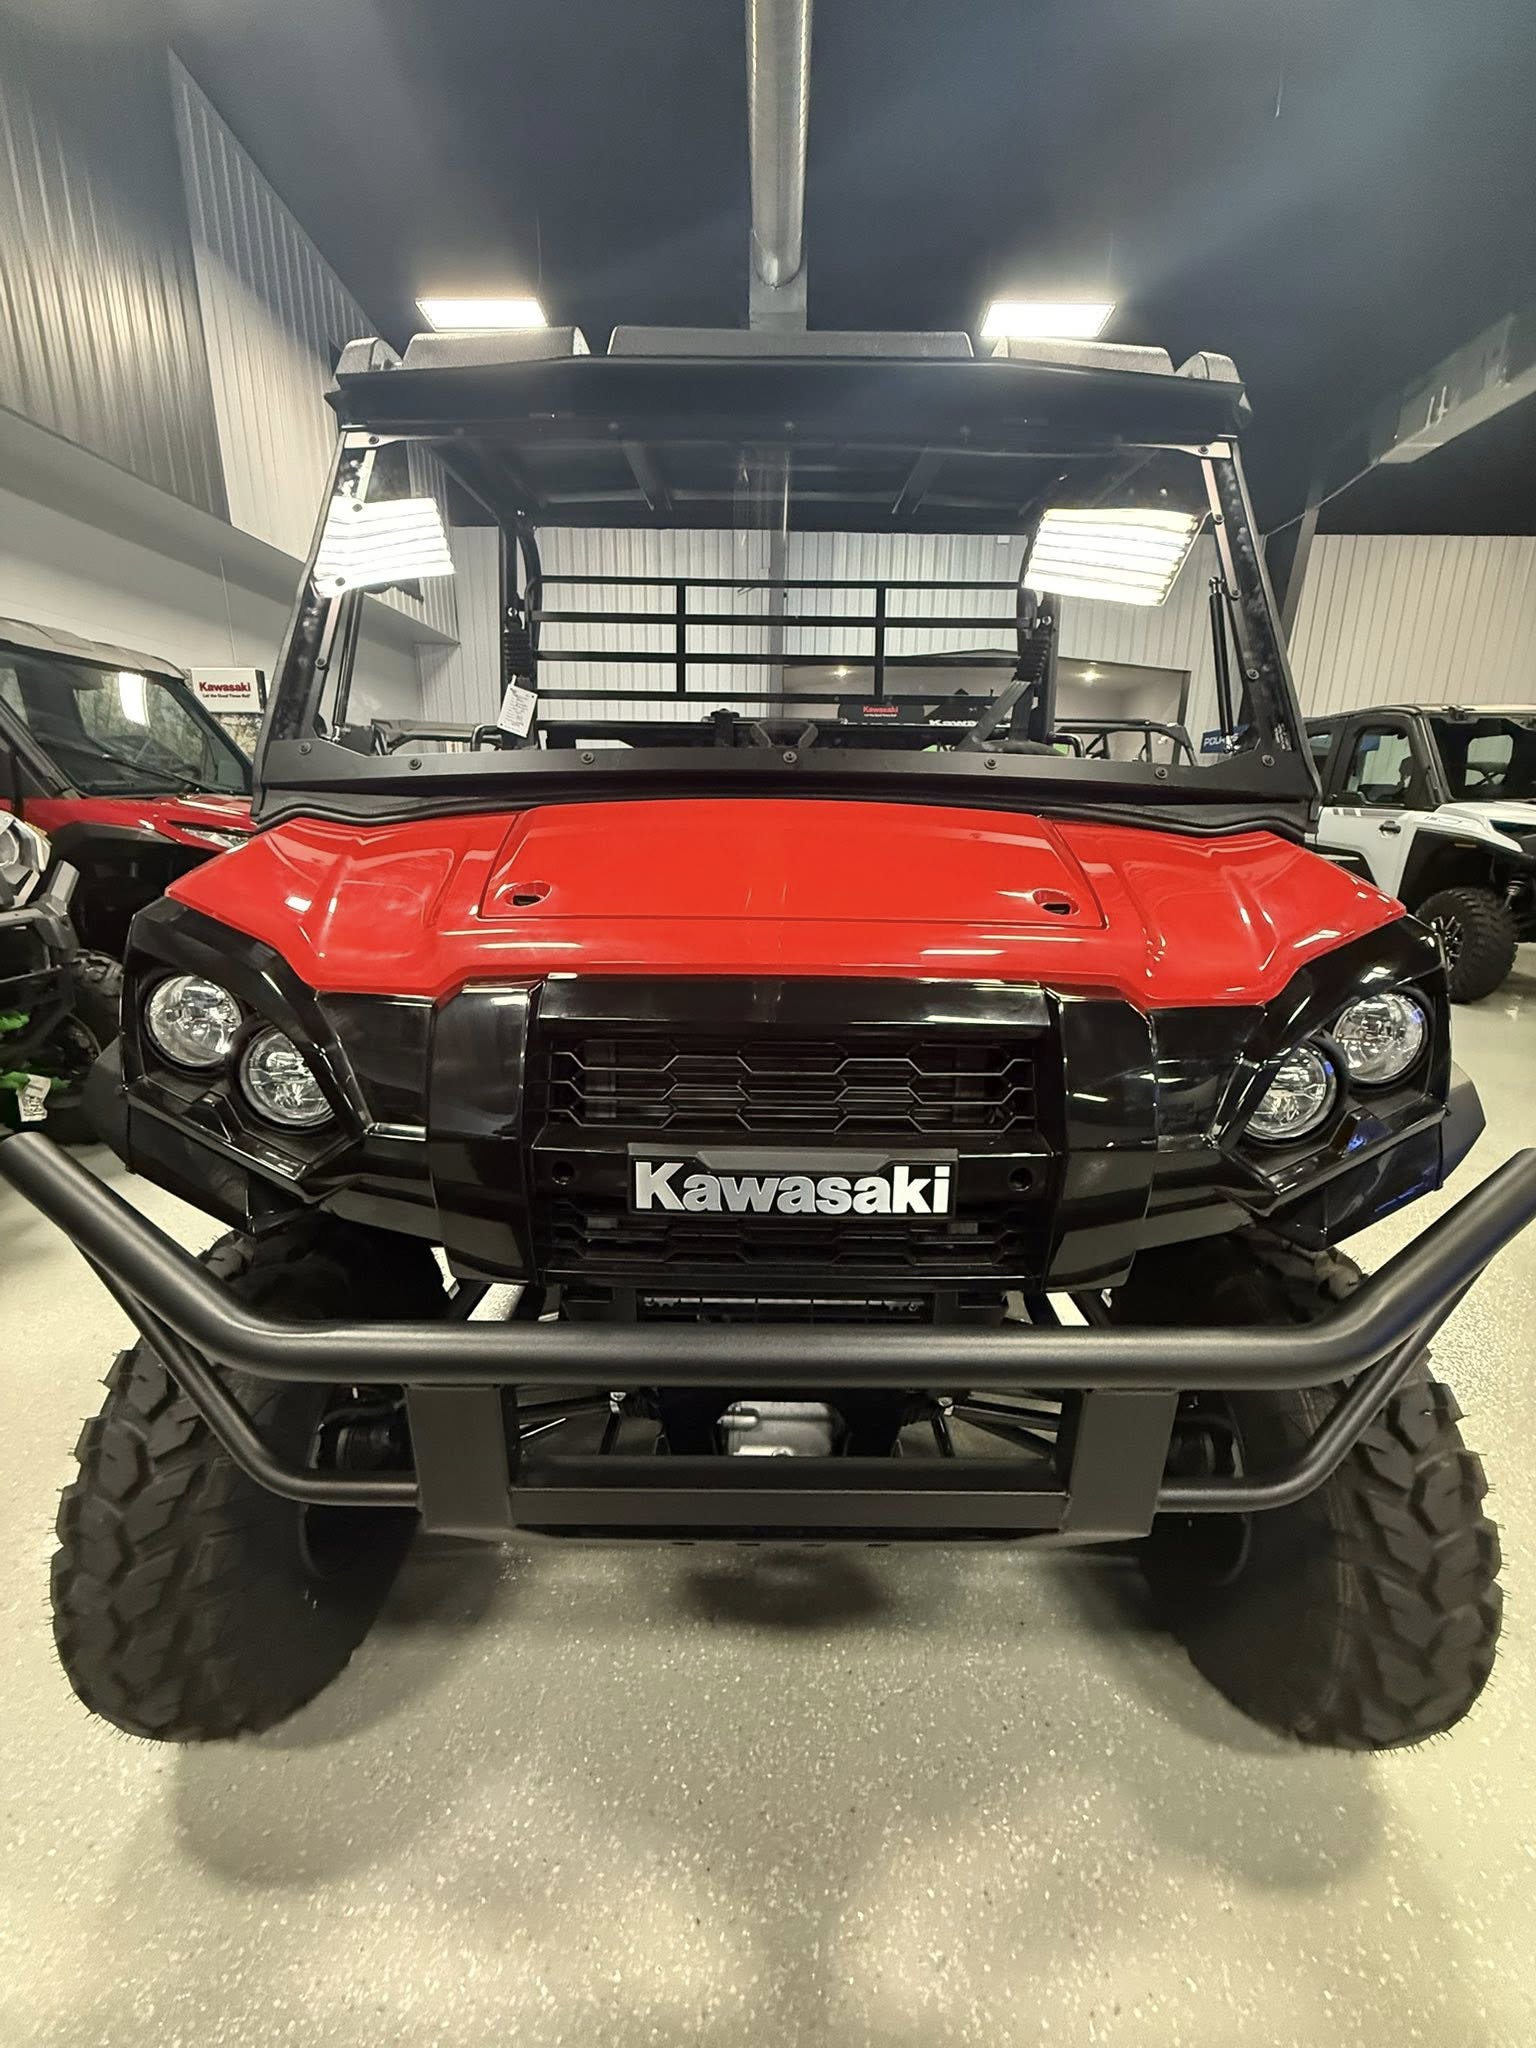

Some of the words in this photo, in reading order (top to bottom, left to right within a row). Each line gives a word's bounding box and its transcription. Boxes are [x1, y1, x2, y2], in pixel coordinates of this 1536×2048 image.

[199, 682, 251, 692] Kawasaki
[863, 705, 899, 713] Kawasaki
[635, 1161, 950, 1214] Kawasaki
